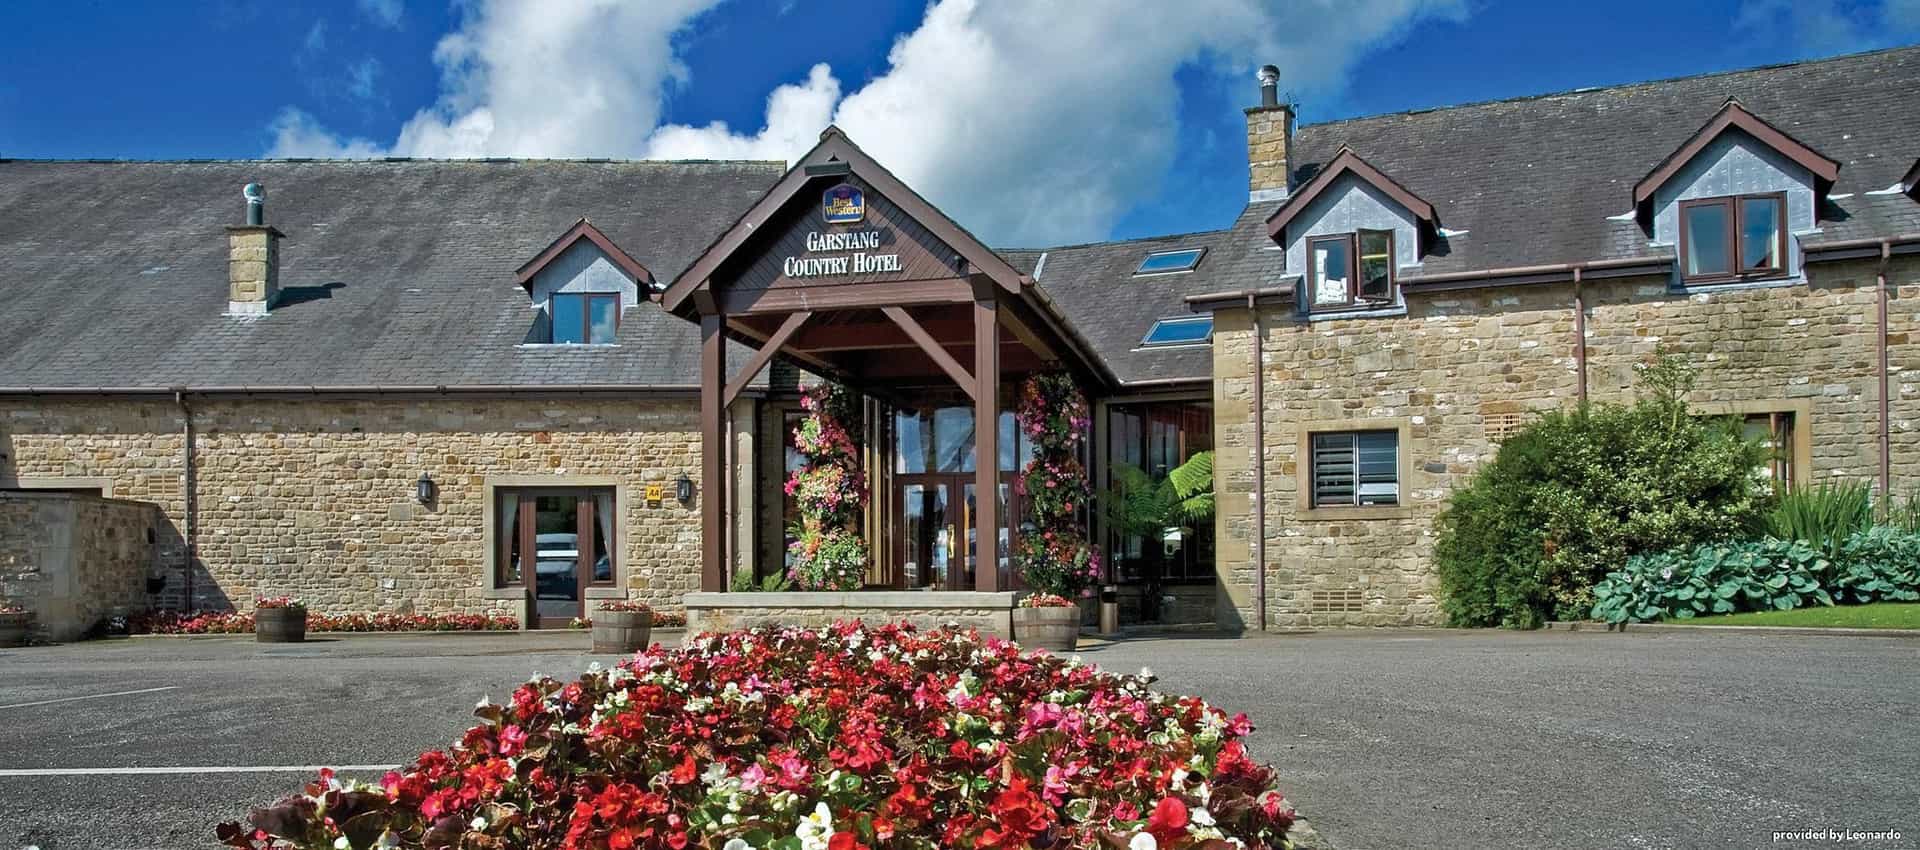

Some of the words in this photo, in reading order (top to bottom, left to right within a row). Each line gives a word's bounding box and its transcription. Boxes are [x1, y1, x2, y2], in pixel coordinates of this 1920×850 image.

[833, 197, 852, 206] Best
[825, 206, 861, 215] Western
[806, 231, 880, 251] GARSTANG
[784, 256, 849, 277] COUNTRY
[853, 252, 902, 273] HOTEL
